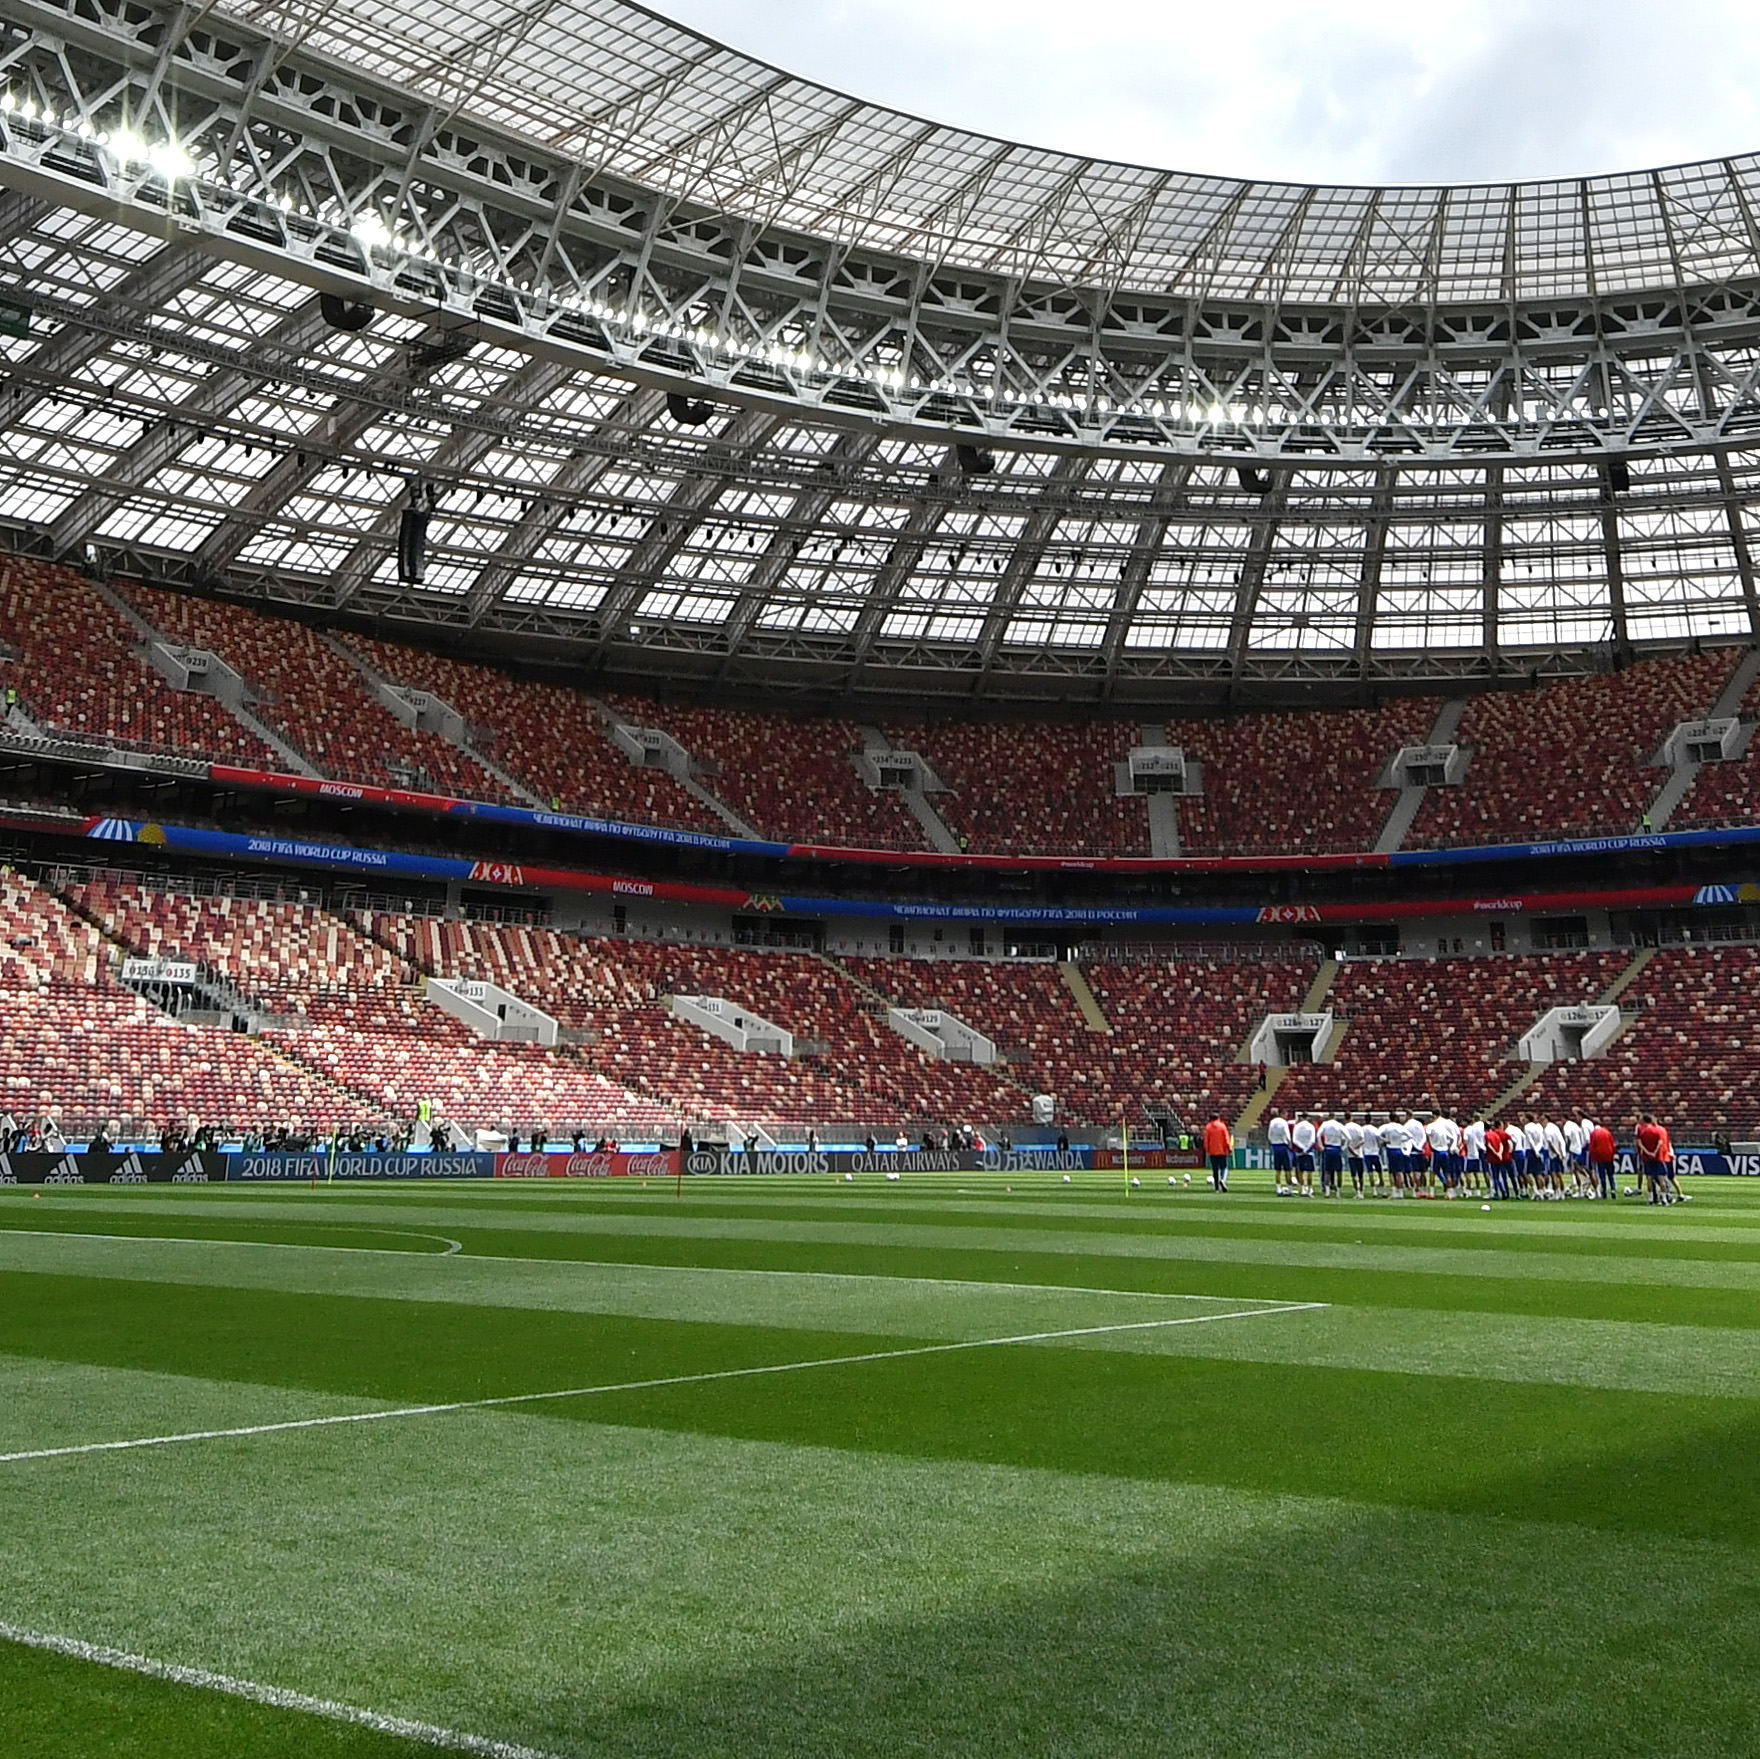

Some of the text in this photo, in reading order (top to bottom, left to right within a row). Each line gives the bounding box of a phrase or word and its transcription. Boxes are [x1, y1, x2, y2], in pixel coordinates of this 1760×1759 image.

[320, 783, 364, 799] MOSCOW
[248, 839, 387, 865] 2018 FIFA WORLD CUP RUSSIA
[1608, 839, 1628, 850] CUP
[613, 880, 653, 896] MOSCOW
[242, 1157, 478, 1177] 2018 FIFA WORLD CUP RUSSIA
[692, 1157, 713, 1171] KIA
[721, 1152, 829, 1174] KIA MOTORS
[851, 1152, 960, 1172] QATAR AIRWAYS
[45, 1173, 83, 1184] adidas
[110, 1173, 148, 1184] adidas
[172, 1172, 208, 1183] adidas
